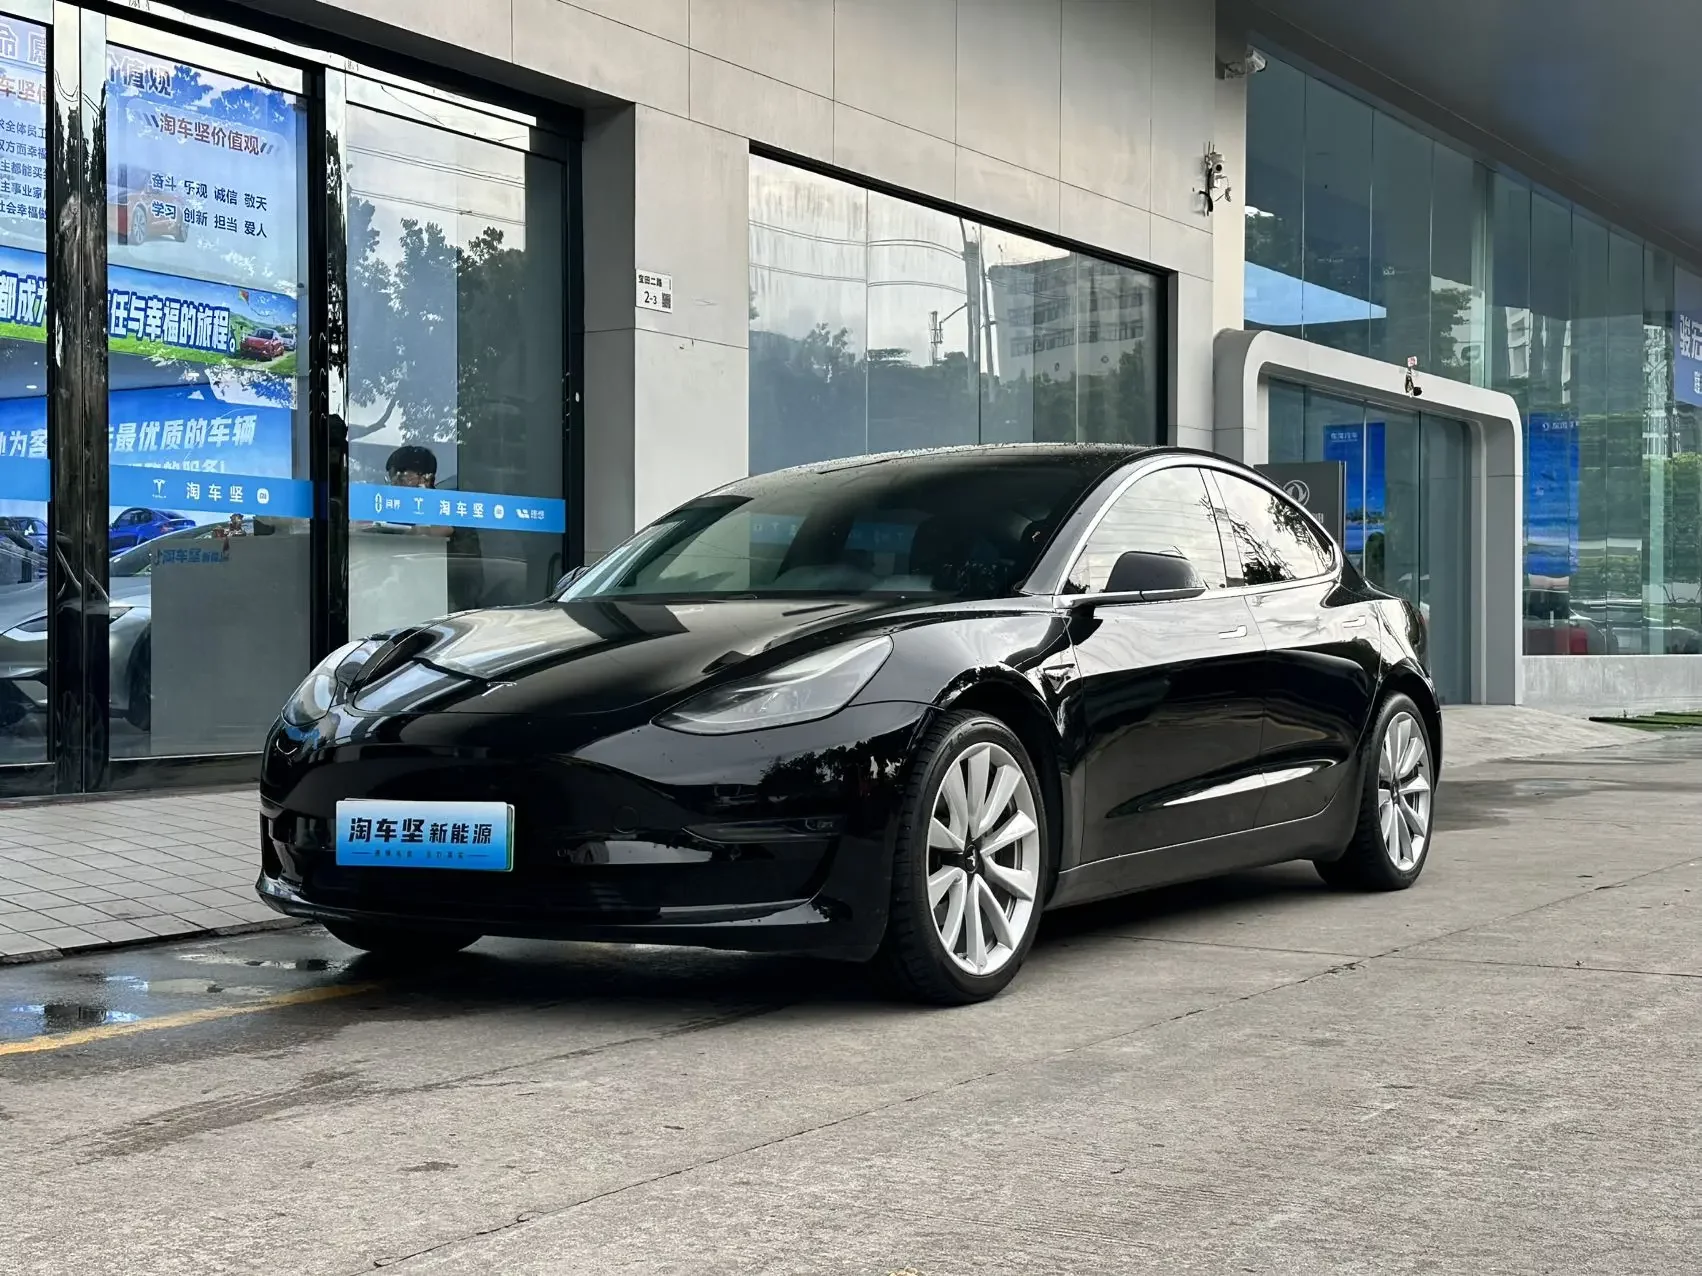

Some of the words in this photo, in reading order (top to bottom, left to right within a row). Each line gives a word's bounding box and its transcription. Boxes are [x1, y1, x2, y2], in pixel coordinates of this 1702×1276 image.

[160, 113, 259, 155] 淘车坚价值观
[0, 180, 46, 200] 主事业家
[152, 173, 176, 191] 奋斗
[184, 180, 208, 198] 乐观
[214, 186, 238, 205] 诚信
[244, 193, 267, 211] 敬天
[152, 201, 176, 219] 学习
[184, 207, 208, 226] 创新
[214, 214, 238, 232] 担当
[244, 220, 267, 238] 爱人
[644, 290, 657, 305] 2-3
[109, 414, 258, 453] 最优质的车辆
[186, 481, 243, 503] 淘车坚
[439, 500, 484, 518] 淘车坚
[348, 817, 492, 845] 淘车坚新能源
